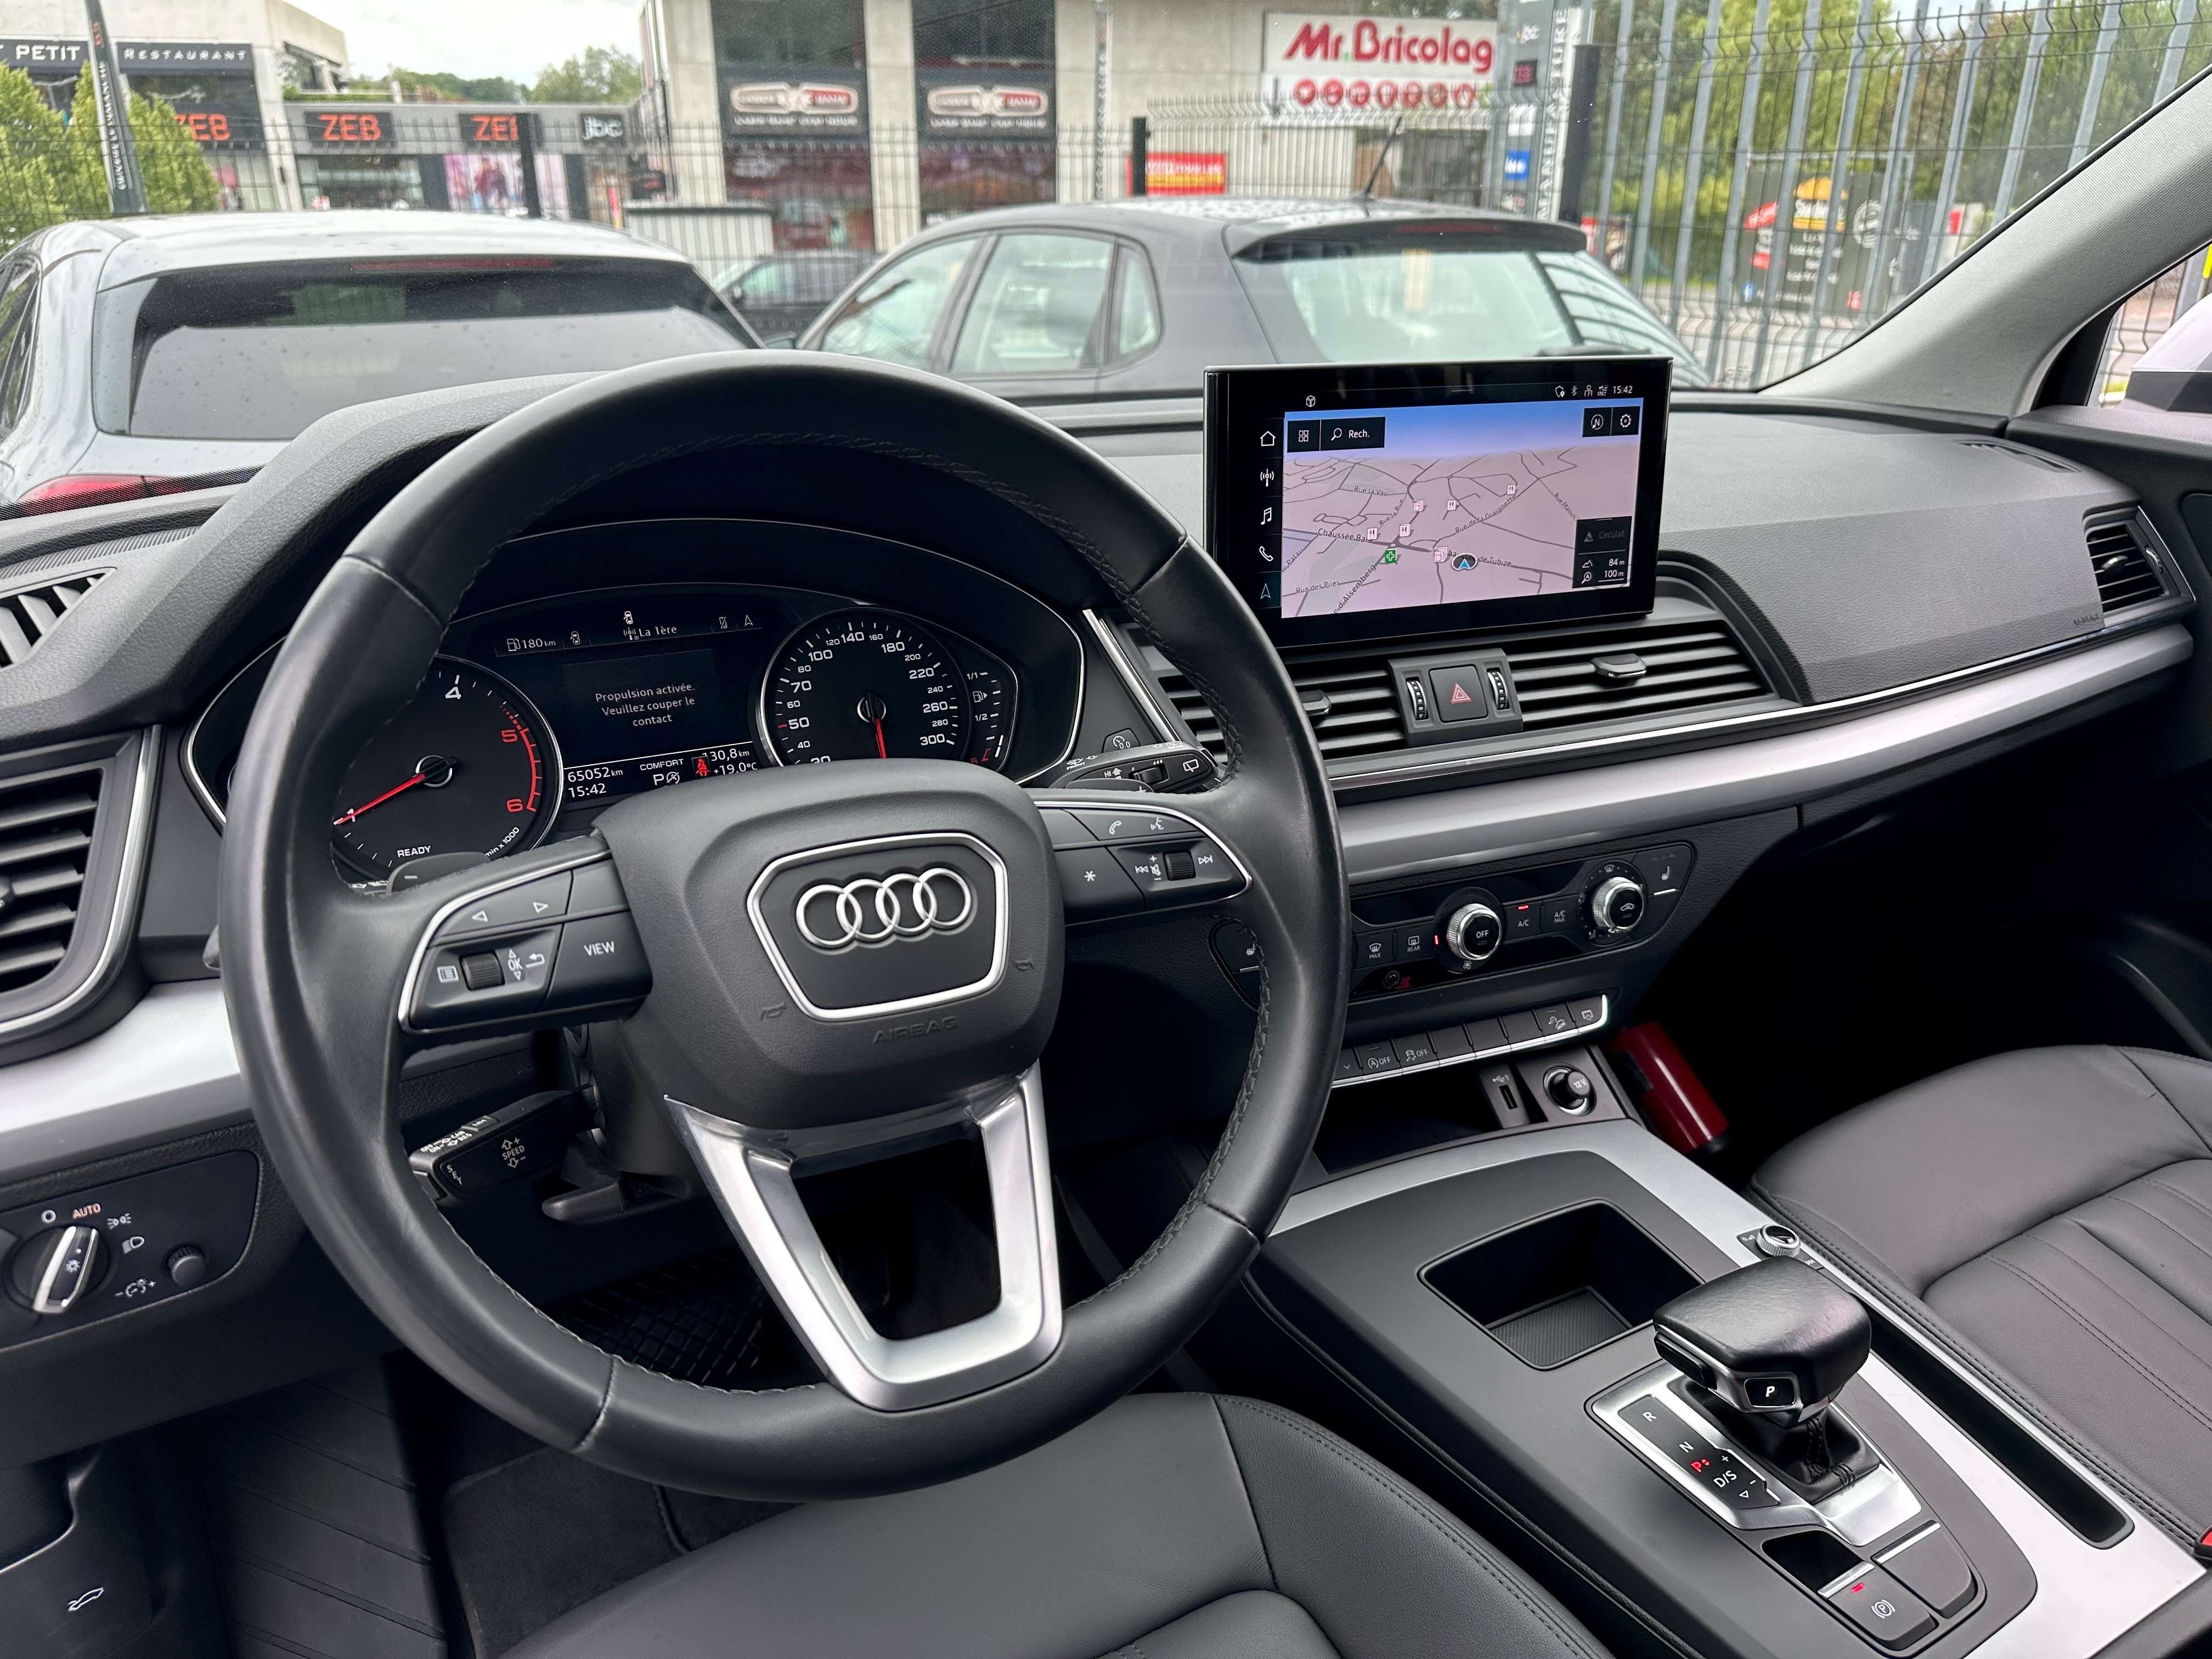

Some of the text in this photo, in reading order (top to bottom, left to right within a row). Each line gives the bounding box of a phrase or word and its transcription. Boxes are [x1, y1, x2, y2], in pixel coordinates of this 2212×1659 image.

[16, 44, 80, 61] PETIT
[319, 114, 380, 141] ZEB
[1613, 386, 1633, 394] 15:42
[1348, 428, 1370, 439] Rech.
[1379, 517, 1390, 526] Rue
[1395, 499, 1404, 511] Rue
[1455, 524, 1468, 533] Rue
[1286, 548, 1303, 566] Palau
[1489, 556, 1511, 567] Tubize
[1604, 569, 1617, 578] 100
[639, 625, 677, 637] La 1ère
[841, 631, 865, 644] 140
[522, 638, 543, 649] 180
[881, 641, 905, 653] 180
[808, 649, 833, 662] 100
[905, 653, 921, 661] 200
[798, 665, 811, 673] 80
[909, 667, 934, 679] 220
[445, 686, 461, 699] 4
[790, 680, 811, 693] 70
[595, 685, 653, 703] Propulsion
[602, 696, 695, 715] Veuillez couper le
[787, 700, 800, 708] 60
[922, 701, 948, 714] 260
[633, 714, 672, 727] contact
[788, 716, 810, 730] 50
[932, 718, 948, 727] 280
[501, 730, 517, 742] 5
[919, 733, 945, 747] 300
[797, 740, 811, 749] 40
[640, 758, 684, 771] COMFORT
[1066, 761, 1086, 770] FRONT
[567, 767, 610, 783] 65052
[569, 783, 607, 798] 15:42
[506, 799, 523, 812] 6
[503, 826, 520, 844] 1000
[397, 845, 432, 858] READY
[1554, 910, 1566, 918] A/C
[1517, 919, 1530, 928] A/C
[1476, 929, 1489, 939] OFF
[584, 941, 615, 956] VIEW
[1407, 943, 1420, 952] REAR
[1369, 950, 1381, 960] MAX
[508, 958, 523, 971] OK
[872, 1016, 957, 1044] AIRBAG
[1416, 1048, 1429, 1057] OFF
[1379, 1056, 1391, 1065] OFF
[501, 1144, 525, 1161] SPEED
[447, 1164, 462, 1185] SET
[72, 1203, 101, 1220] AUTO
[1765, 1384, 1776, 1398] P
[1643, 1410, 1657, 1423] R
[1679, 1440, 1694, 1453] N
[1713, 1469, 1738, 1488] D/S
